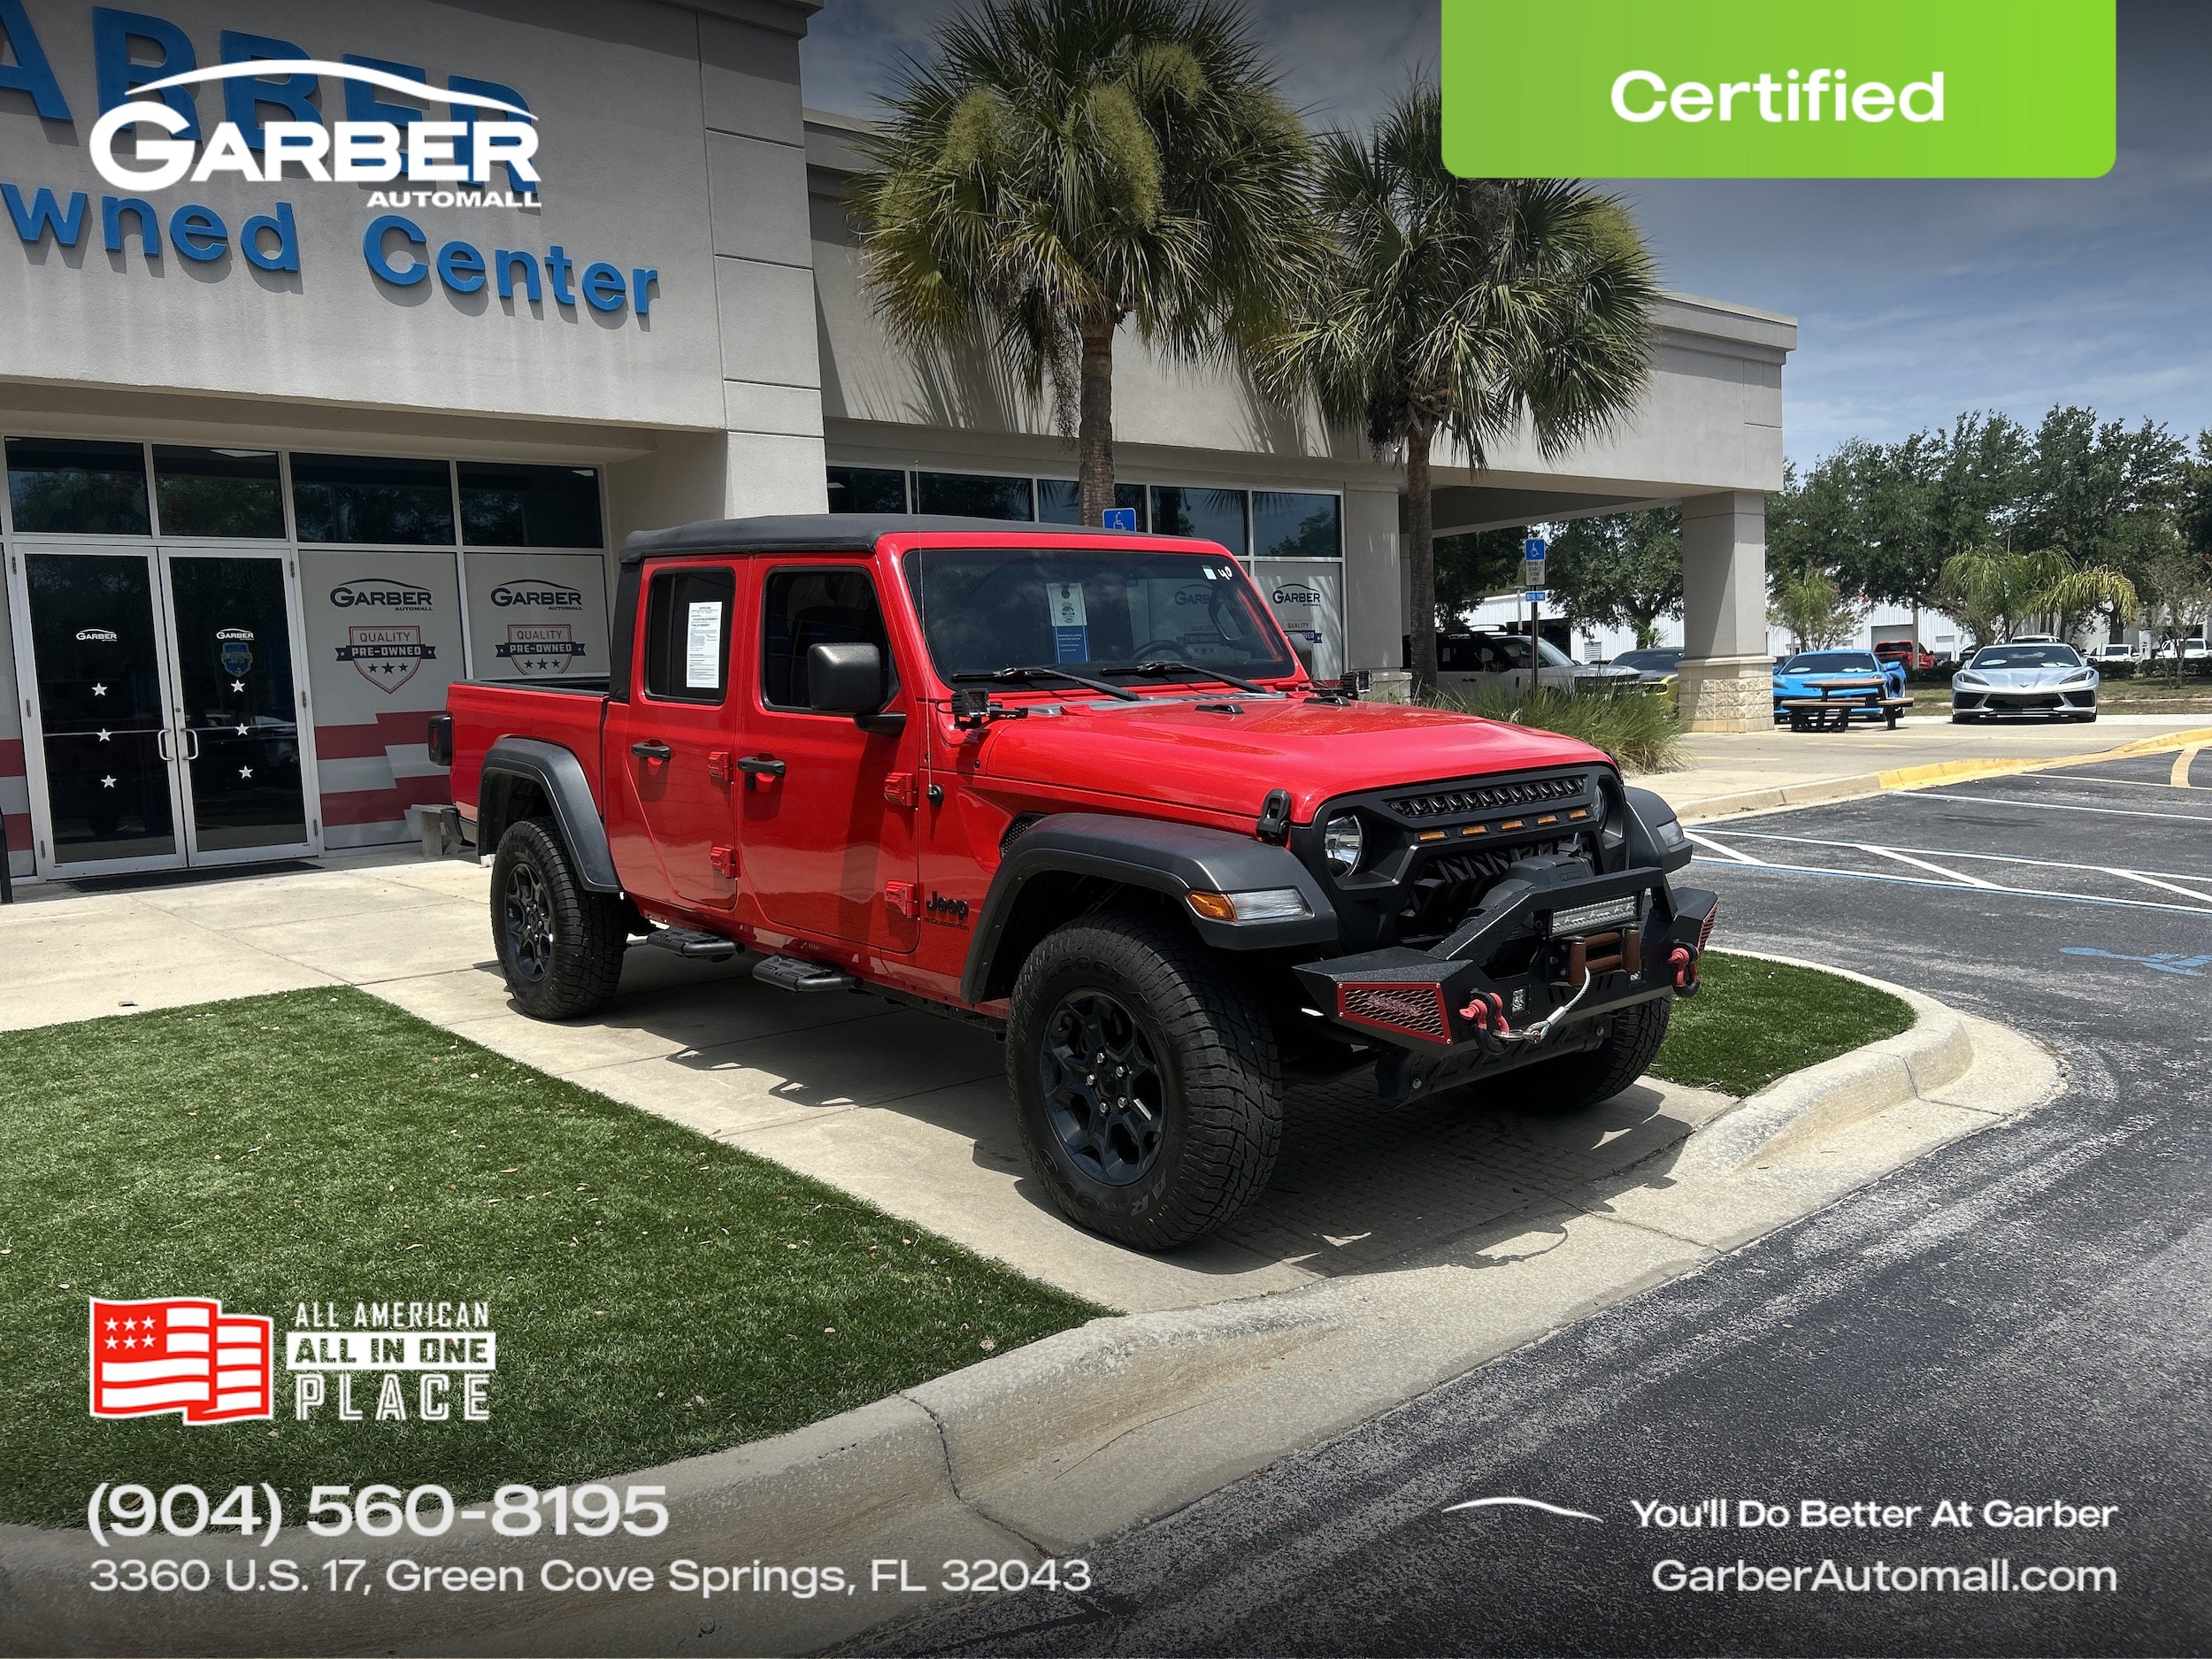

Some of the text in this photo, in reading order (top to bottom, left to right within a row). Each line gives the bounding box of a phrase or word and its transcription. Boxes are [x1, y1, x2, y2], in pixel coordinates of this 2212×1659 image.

[2, 183, 659, 317] wned Center
[330, 587, 434, 608] GARBER
[490, 588, 582, 607] GARBER
[1272, 590, 1321, 603] GARBER
[359, 632, 411, 642] QUALITY
[517, 630, 563, 640] QUALITY
[351, 646, 422, 657] PRE-OWNED
[510, 643, 572, 654] PRE-OWNED
[926, 890, 969, 919] Jeep
